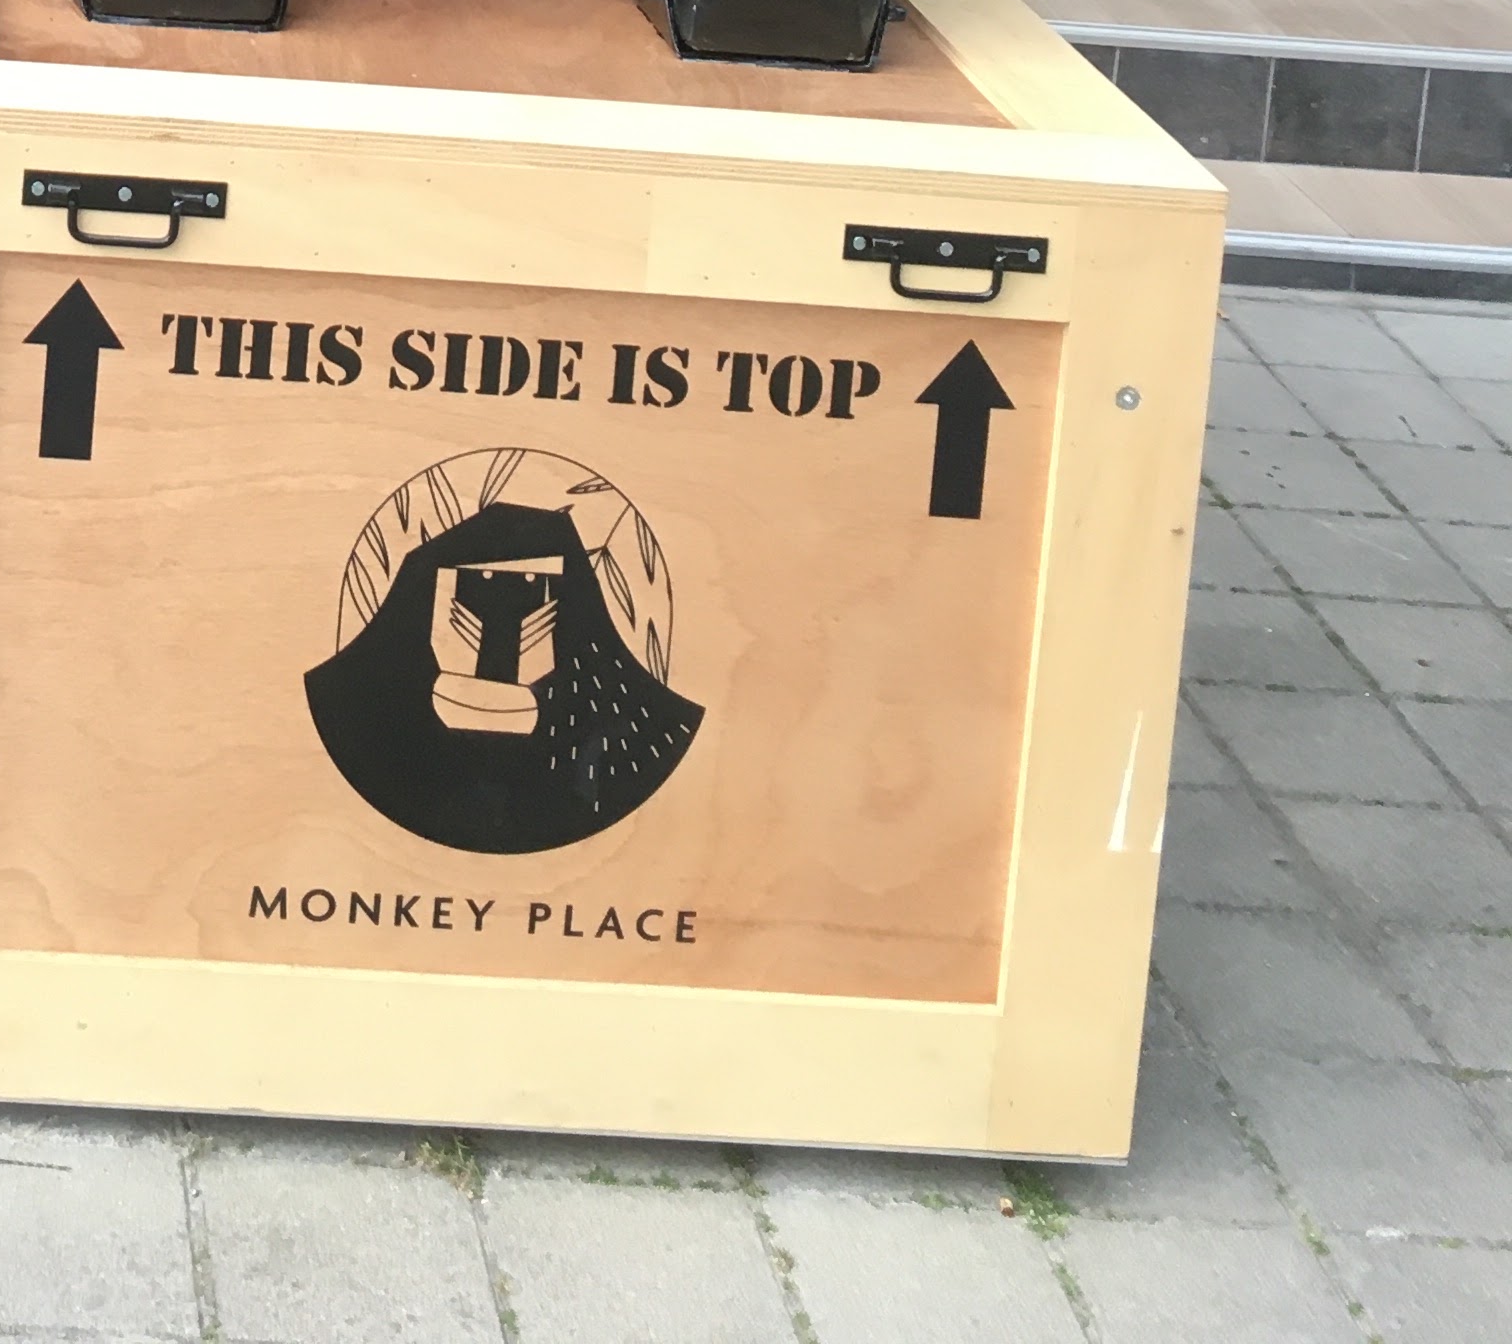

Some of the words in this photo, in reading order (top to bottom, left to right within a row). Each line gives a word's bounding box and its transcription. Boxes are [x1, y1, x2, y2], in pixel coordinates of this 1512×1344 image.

[161, 314, 363, 386] THIS
[388, 329, 584, 401] SIDE
[607, 344, 690, 408] IS
[716, 351, 881, 420] TOP
[248, 885, 495, 932] MONKEY
[528, 902, 698, 944] PLACE
